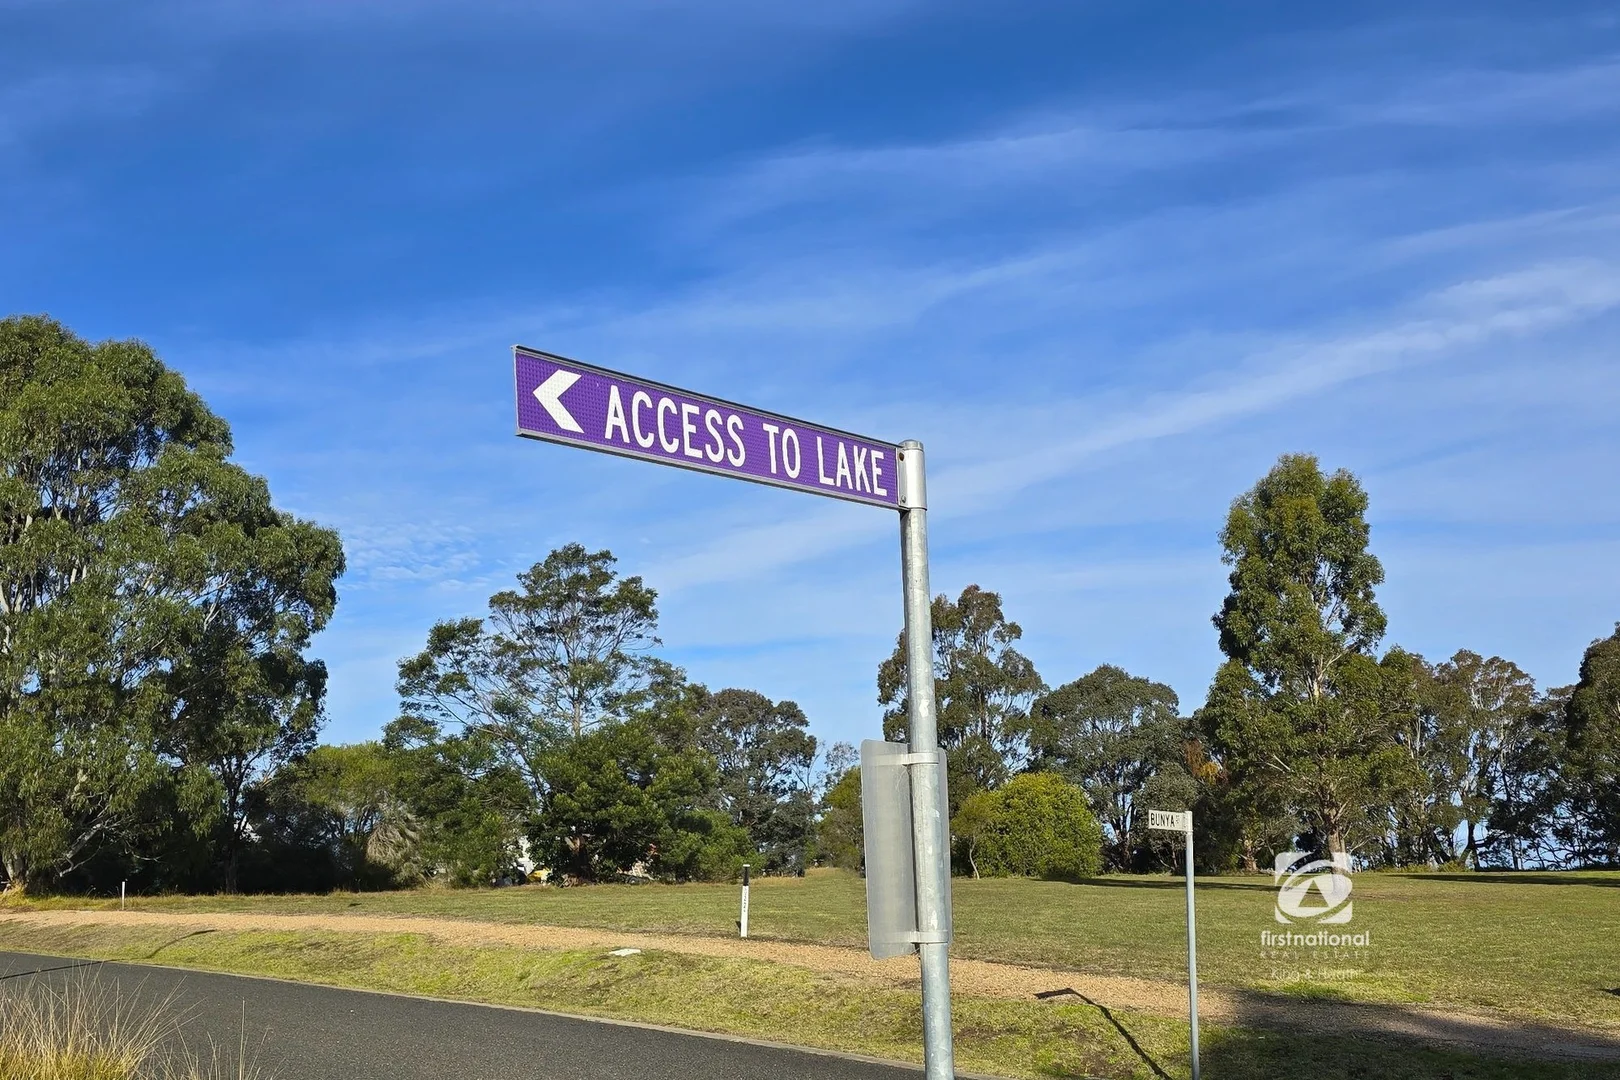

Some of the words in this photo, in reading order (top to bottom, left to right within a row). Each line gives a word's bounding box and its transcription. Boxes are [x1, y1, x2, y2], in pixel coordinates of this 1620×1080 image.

[604, 384, 746, 467] ACCESS
[762, 423, 802, 479] TO
[816, 436, 888, 496] LAKE
[1150, 812, 1175, 828] BUNYA
